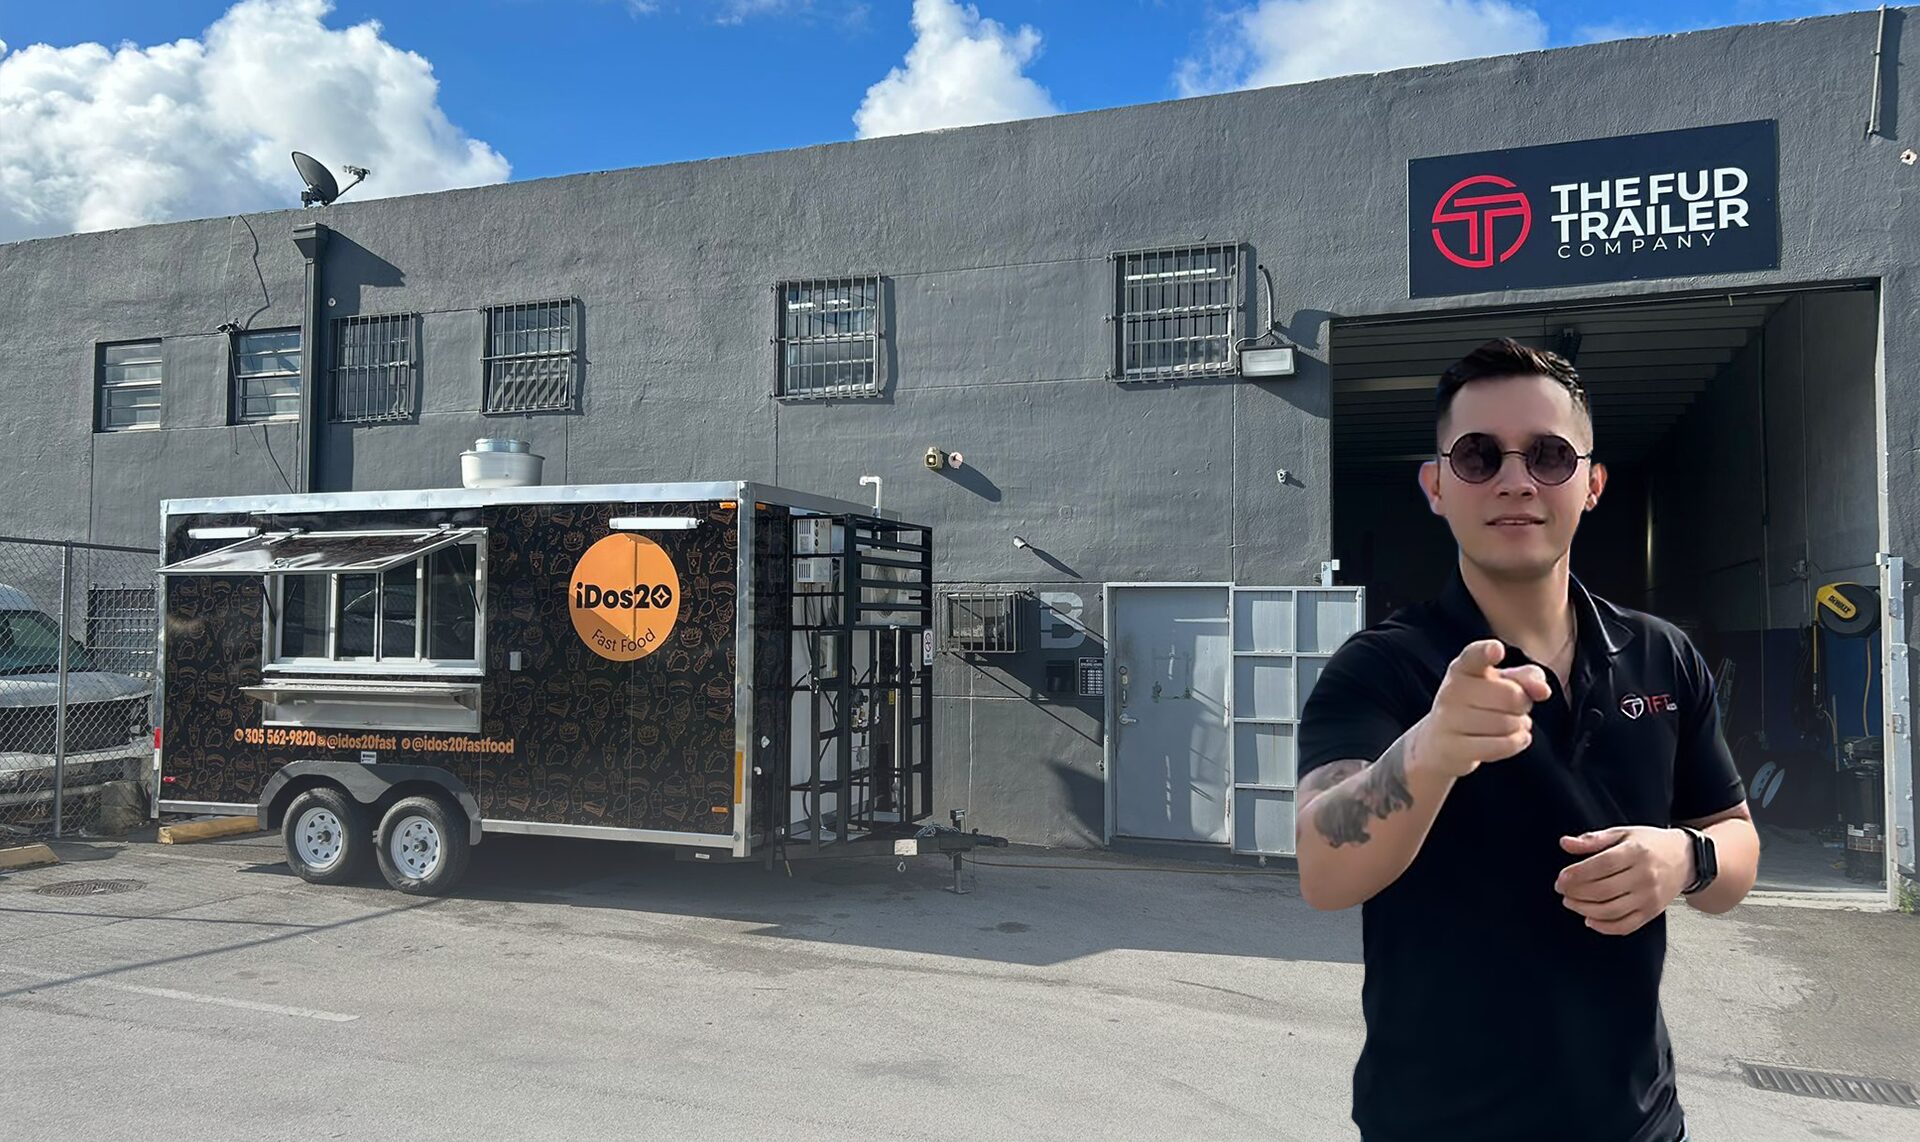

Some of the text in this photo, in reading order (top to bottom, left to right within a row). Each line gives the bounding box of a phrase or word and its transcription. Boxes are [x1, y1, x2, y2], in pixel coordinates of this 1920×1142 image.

[1550, 166, 1749, 214] THE FUD
[1550, 197, 1750, 244] TRAILER
[1557, 232, 1716, 259] COMPANY
[1040, 592, 1087, 649] B
[591, 627, 657, 653] Fast Food
[245, 728, 515, 754] 305 562-9820 @idos20fast @idos20fastfood
